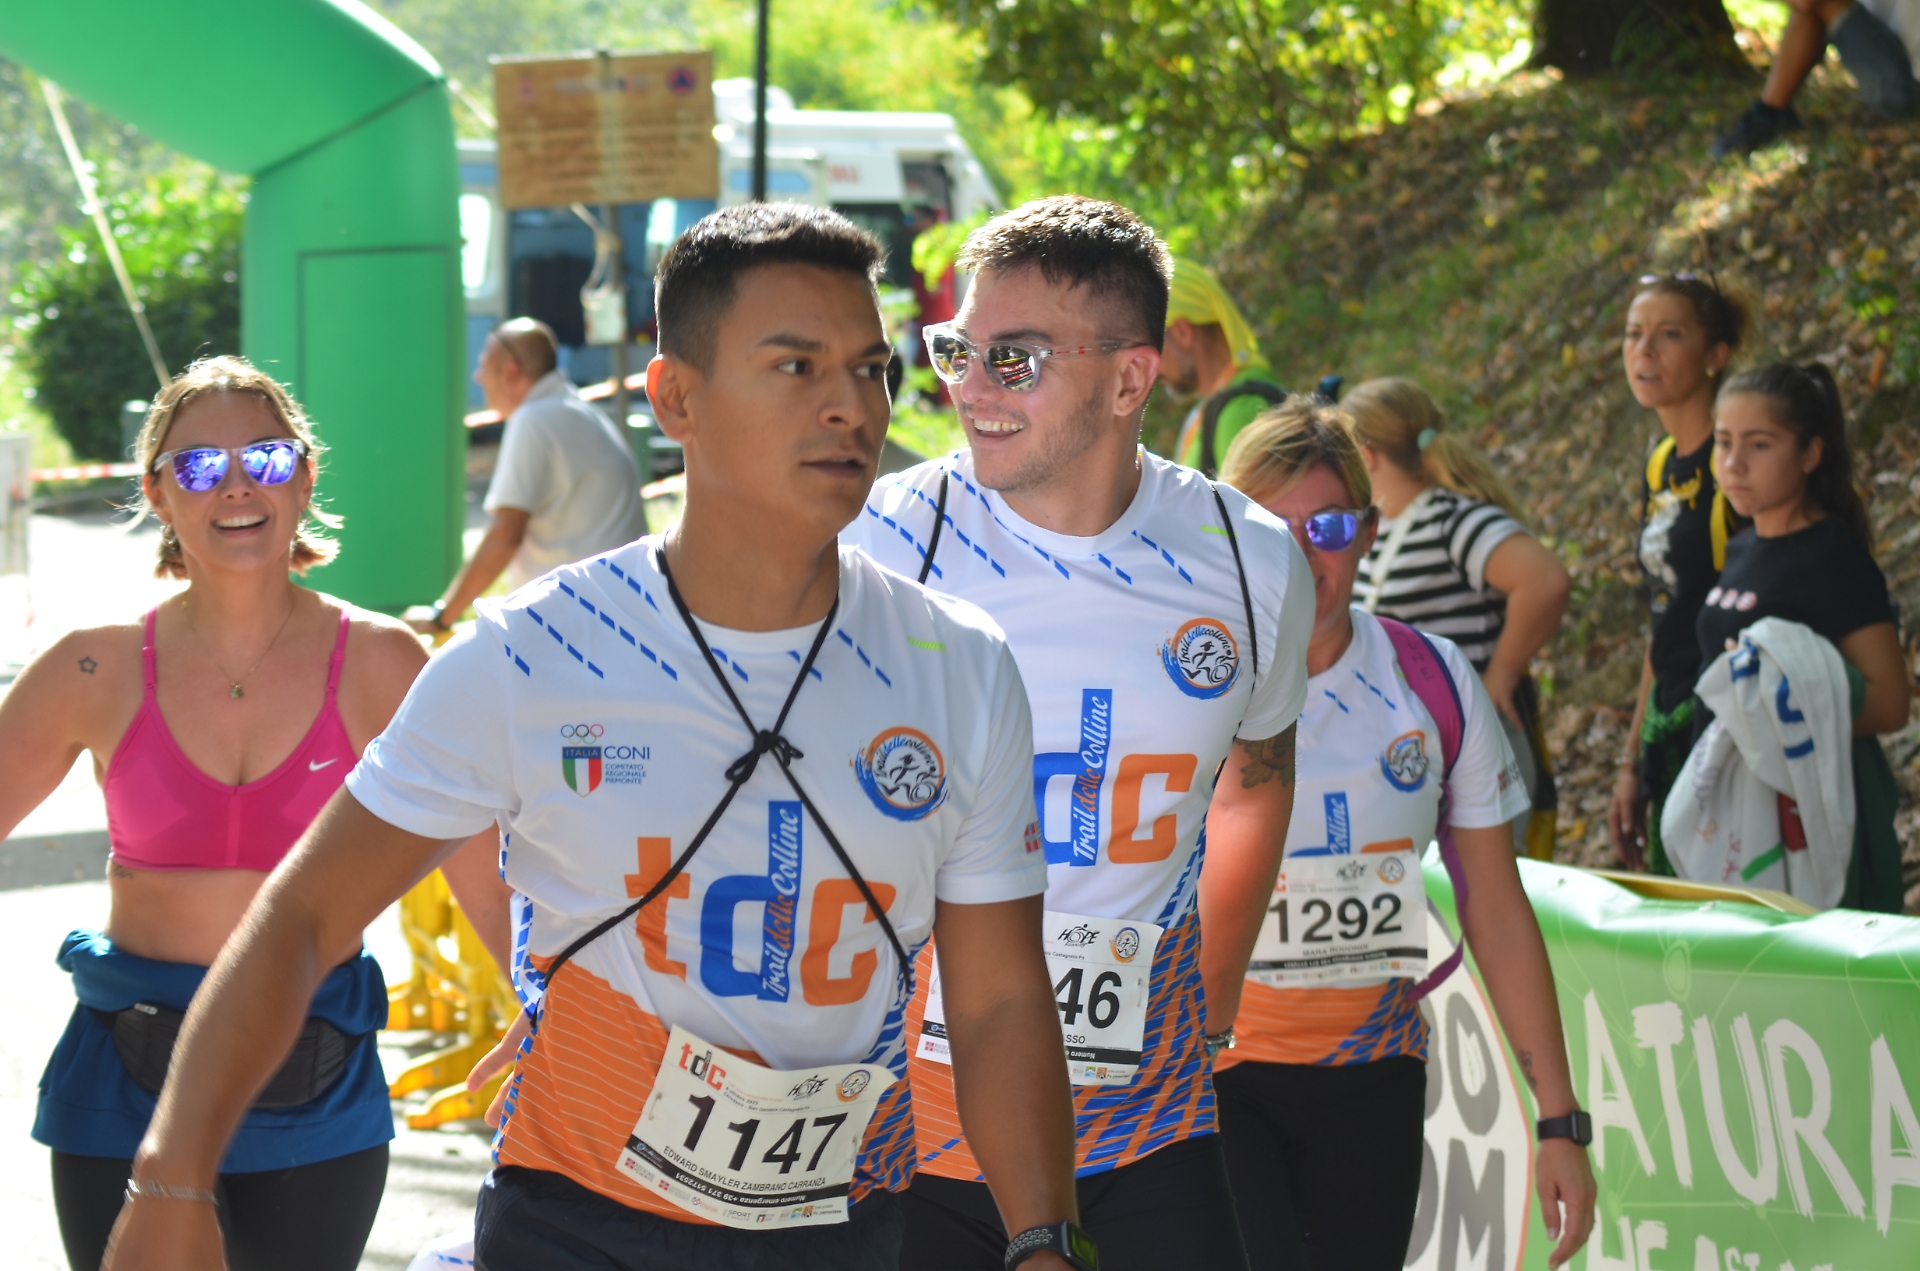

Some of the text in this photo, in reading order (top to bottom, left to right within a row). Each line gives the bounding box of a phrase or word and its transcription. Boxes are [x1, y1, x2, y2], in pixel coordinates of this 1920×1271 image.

[565, 749, 599, 757] ITALIA
[603, 745, 650, 760] CONI
[605, 763, 644, 771] COMITATO
[605, 770, 647, 778] REGIONALE
[605, 777, 642, 785] PIEMONTE
[1268, 892, 1402, 944] 1292
[1054, 966, 1122, 1029] 46
[1071, 1051, 1096, 1060] Numero
[678, 1042, 726, 1091] tdc
[682, 1094, 848, 1175] 1147
[663, 1145, 698, 1172] EDWARD
[698, 1166, 740, 1189] SMAYLER
[740, 1182, 788, 1192] ZAMBRANO
[787, 1177, 826, 1190] CARRANZA
